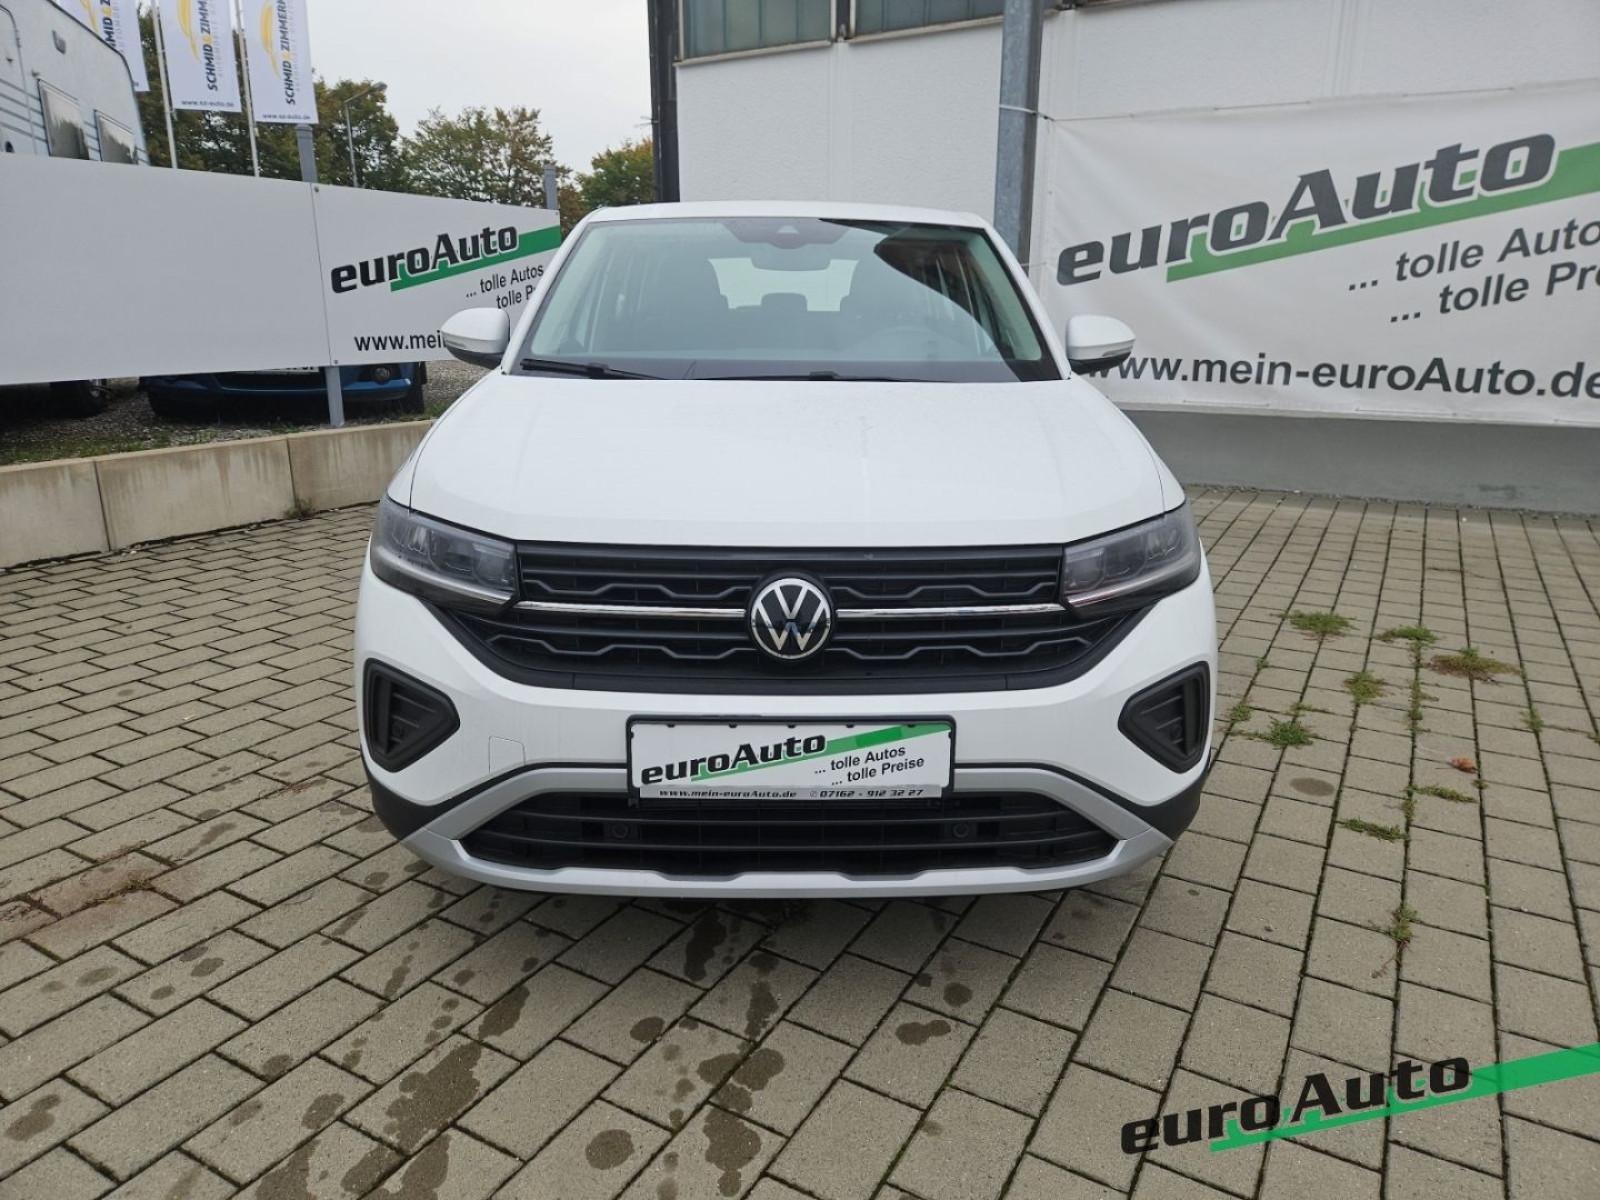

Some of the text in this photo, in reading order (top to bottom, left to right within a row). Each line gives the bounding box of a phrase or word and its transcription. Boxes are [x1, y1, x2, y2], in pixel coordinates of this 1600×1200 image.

[203, 44, 218, 92] SCHMID
[282, 60, 296, 105] SCHMID
[1056, 133, 1556, 286] euroAuto
[330, 226, 518, 294] euroAuto
[1395, 240, 1484, 281] tolle
[1497, 218, 1600, 263] Auto
[480, 273, 506, 293] tolle
[510, 265, 544, 285] Autos
[496, 284, 537, 309] tolle P
[1439, 273, 1529, 314] tolle
[1545, 261, 1600, 296] Pr
[641, 734, 826, 785] euroAuto
[830, 755, 861, 771] tolle
[864, 746, 906, 763] Autos
[847, 767, 877, 782] tolle
[881, 757, 925, 775] Preise
[820, 790, 855, 798] 07162
[908, 789, 924, 797] 27
